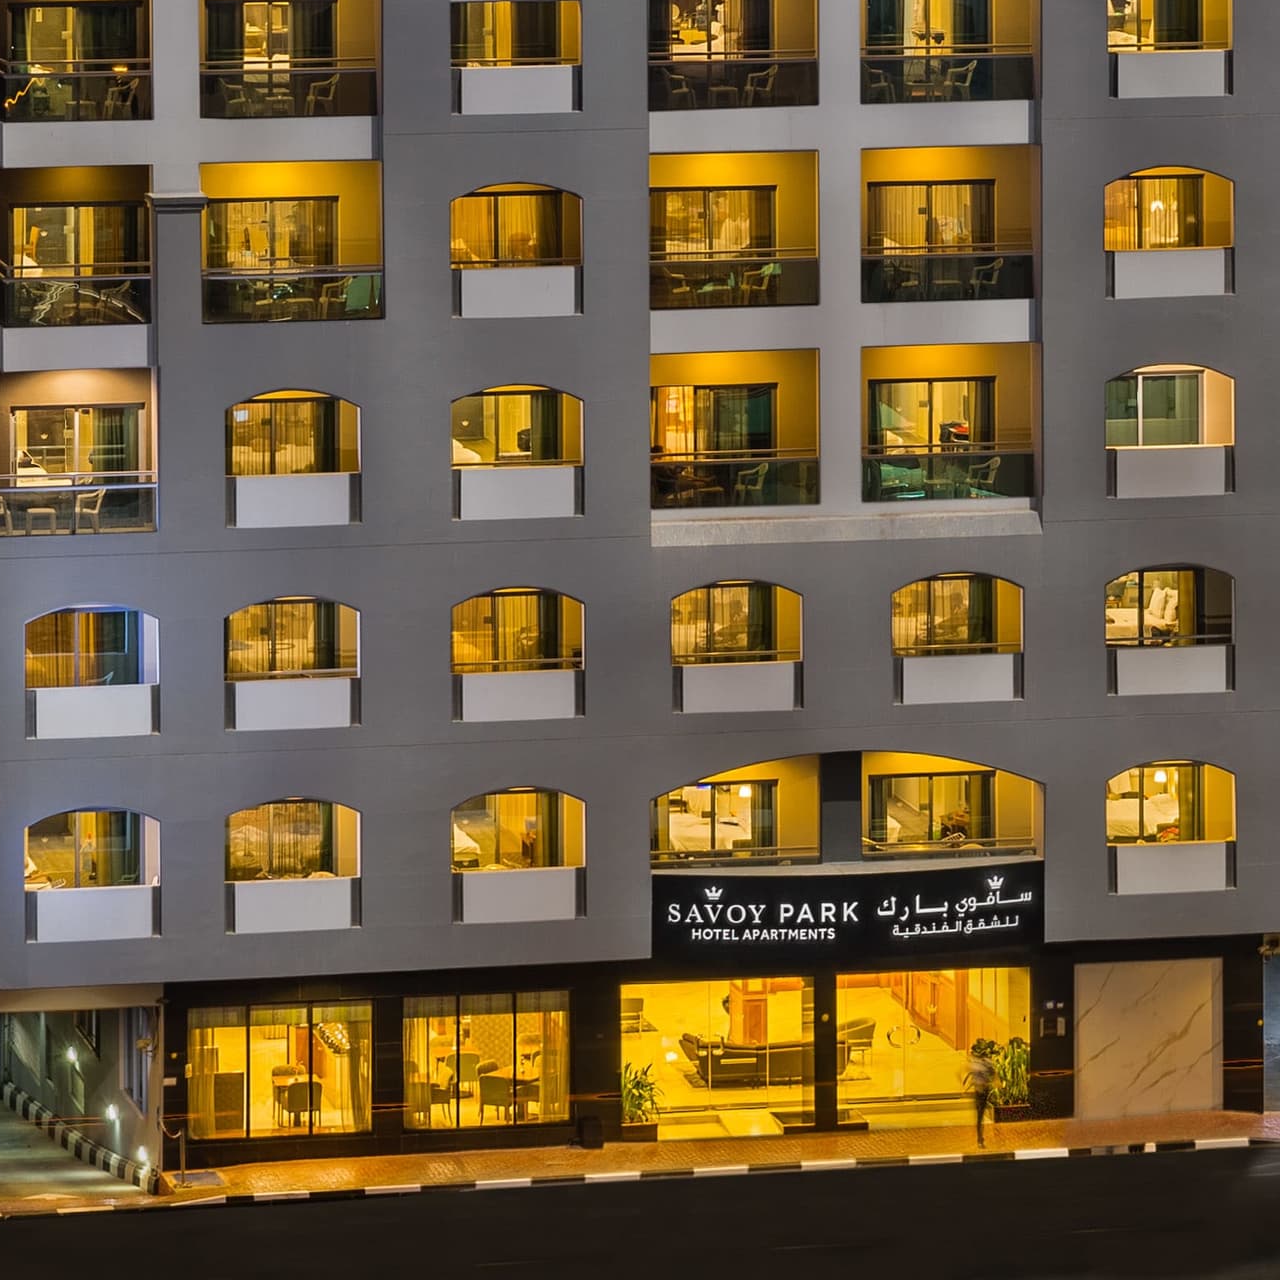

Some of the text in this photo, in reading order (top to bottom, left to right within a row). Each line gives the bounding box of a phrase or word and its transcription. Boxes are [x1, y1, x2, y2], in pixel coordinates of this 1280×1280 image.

[668, 902, 860, 924] SAVOY PARK
[877, 894, 949, 922] بارك
[691, 927, 836, 941] HOTEL APARTMENTS
[892, 914, 1020, 939] للشقق الفندقية
